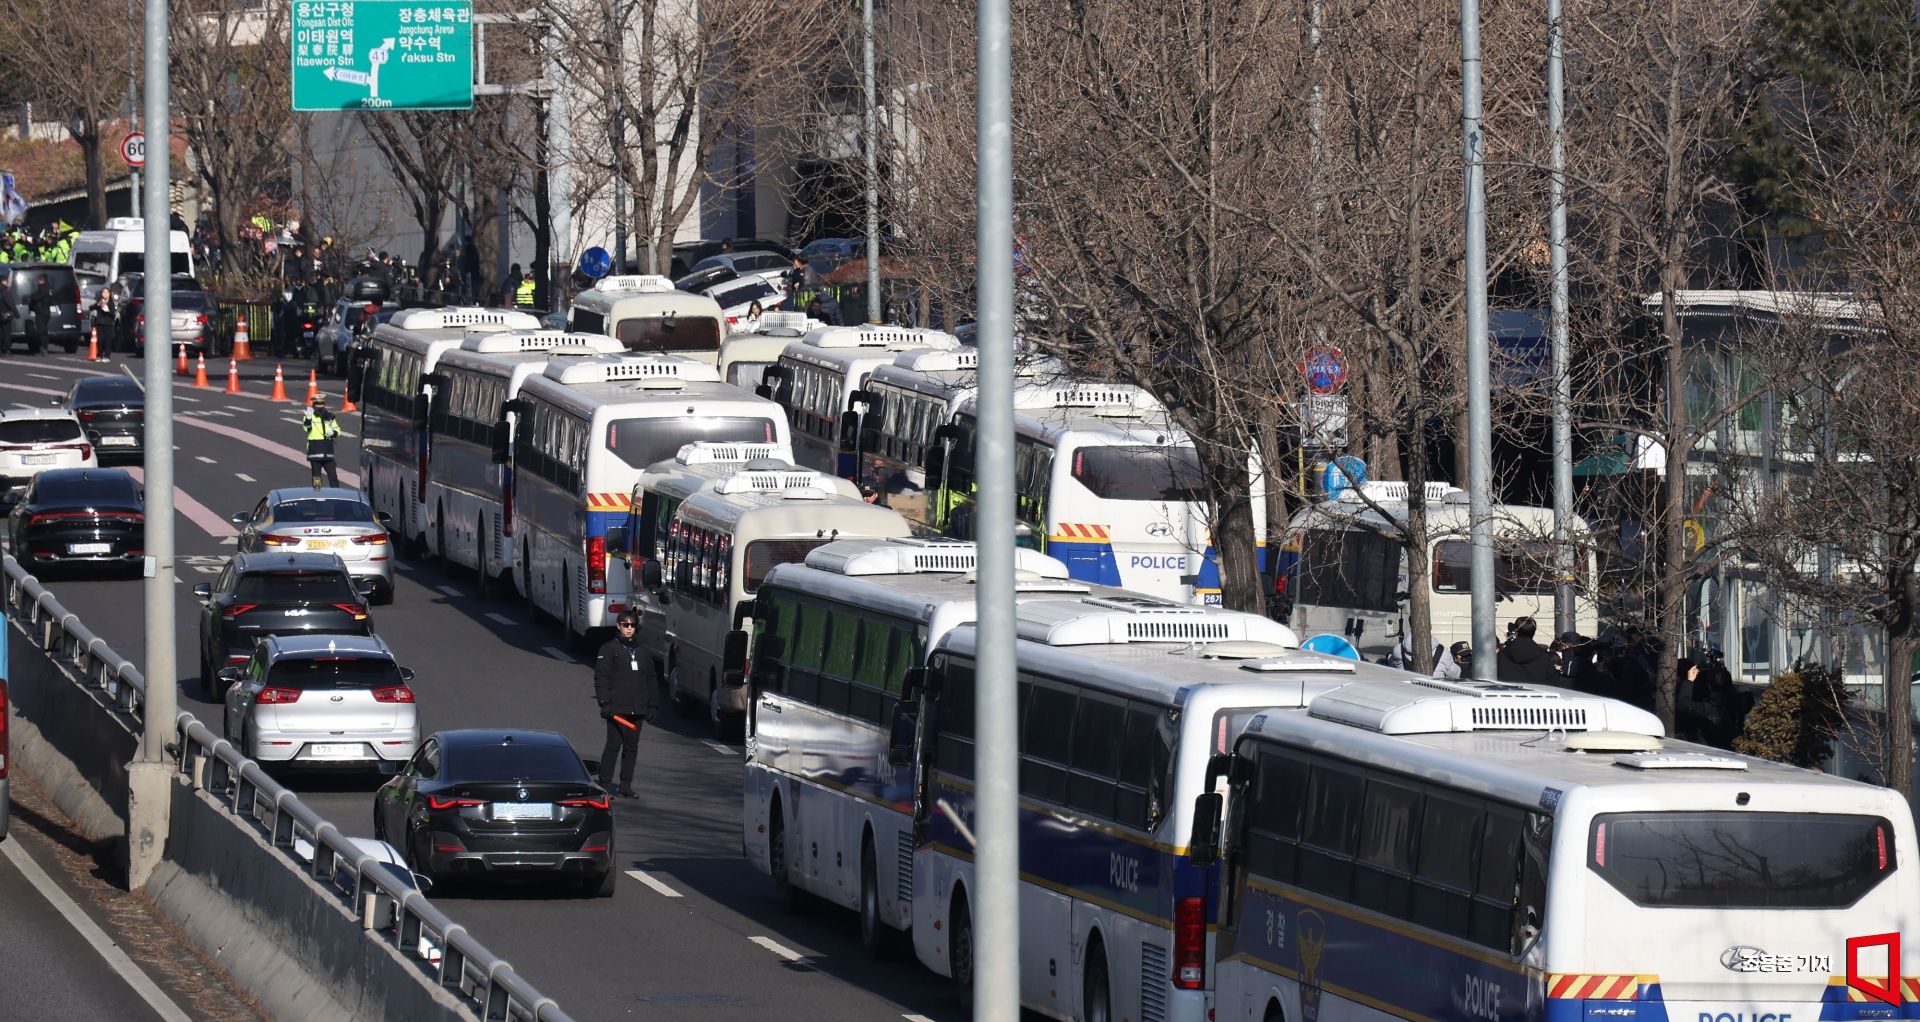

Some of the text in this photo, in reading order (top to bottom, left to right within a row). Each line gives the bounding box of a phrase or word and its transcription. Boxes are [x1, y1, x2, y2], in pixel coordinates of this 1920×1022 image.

[298, 3, 354, 18] 용산구청
[399, 7, 470, 23] 장충체육관
[297, 17, 327, 29] Yongsan
[328, 17, 341, 27] Dist
[399, 24, 455, 36] Jangchung Arena
[298, 29, 354, 44] 이태원역
[399, 36, 441, 51] 약수역
[297, 55, 354, 67] Itaewon Stn
[372, 51, 386, 62] 41
[437, 52, 455, 63] Stn
[361, 97, 393, 108] 200m
[1131, 556, 1186, 570] POLICE
[1110, 850, 1139, 893] POLICE
[1266, 909, 1286, 949] 경찰
[1464, 972, 1501, 1022] POLICE
